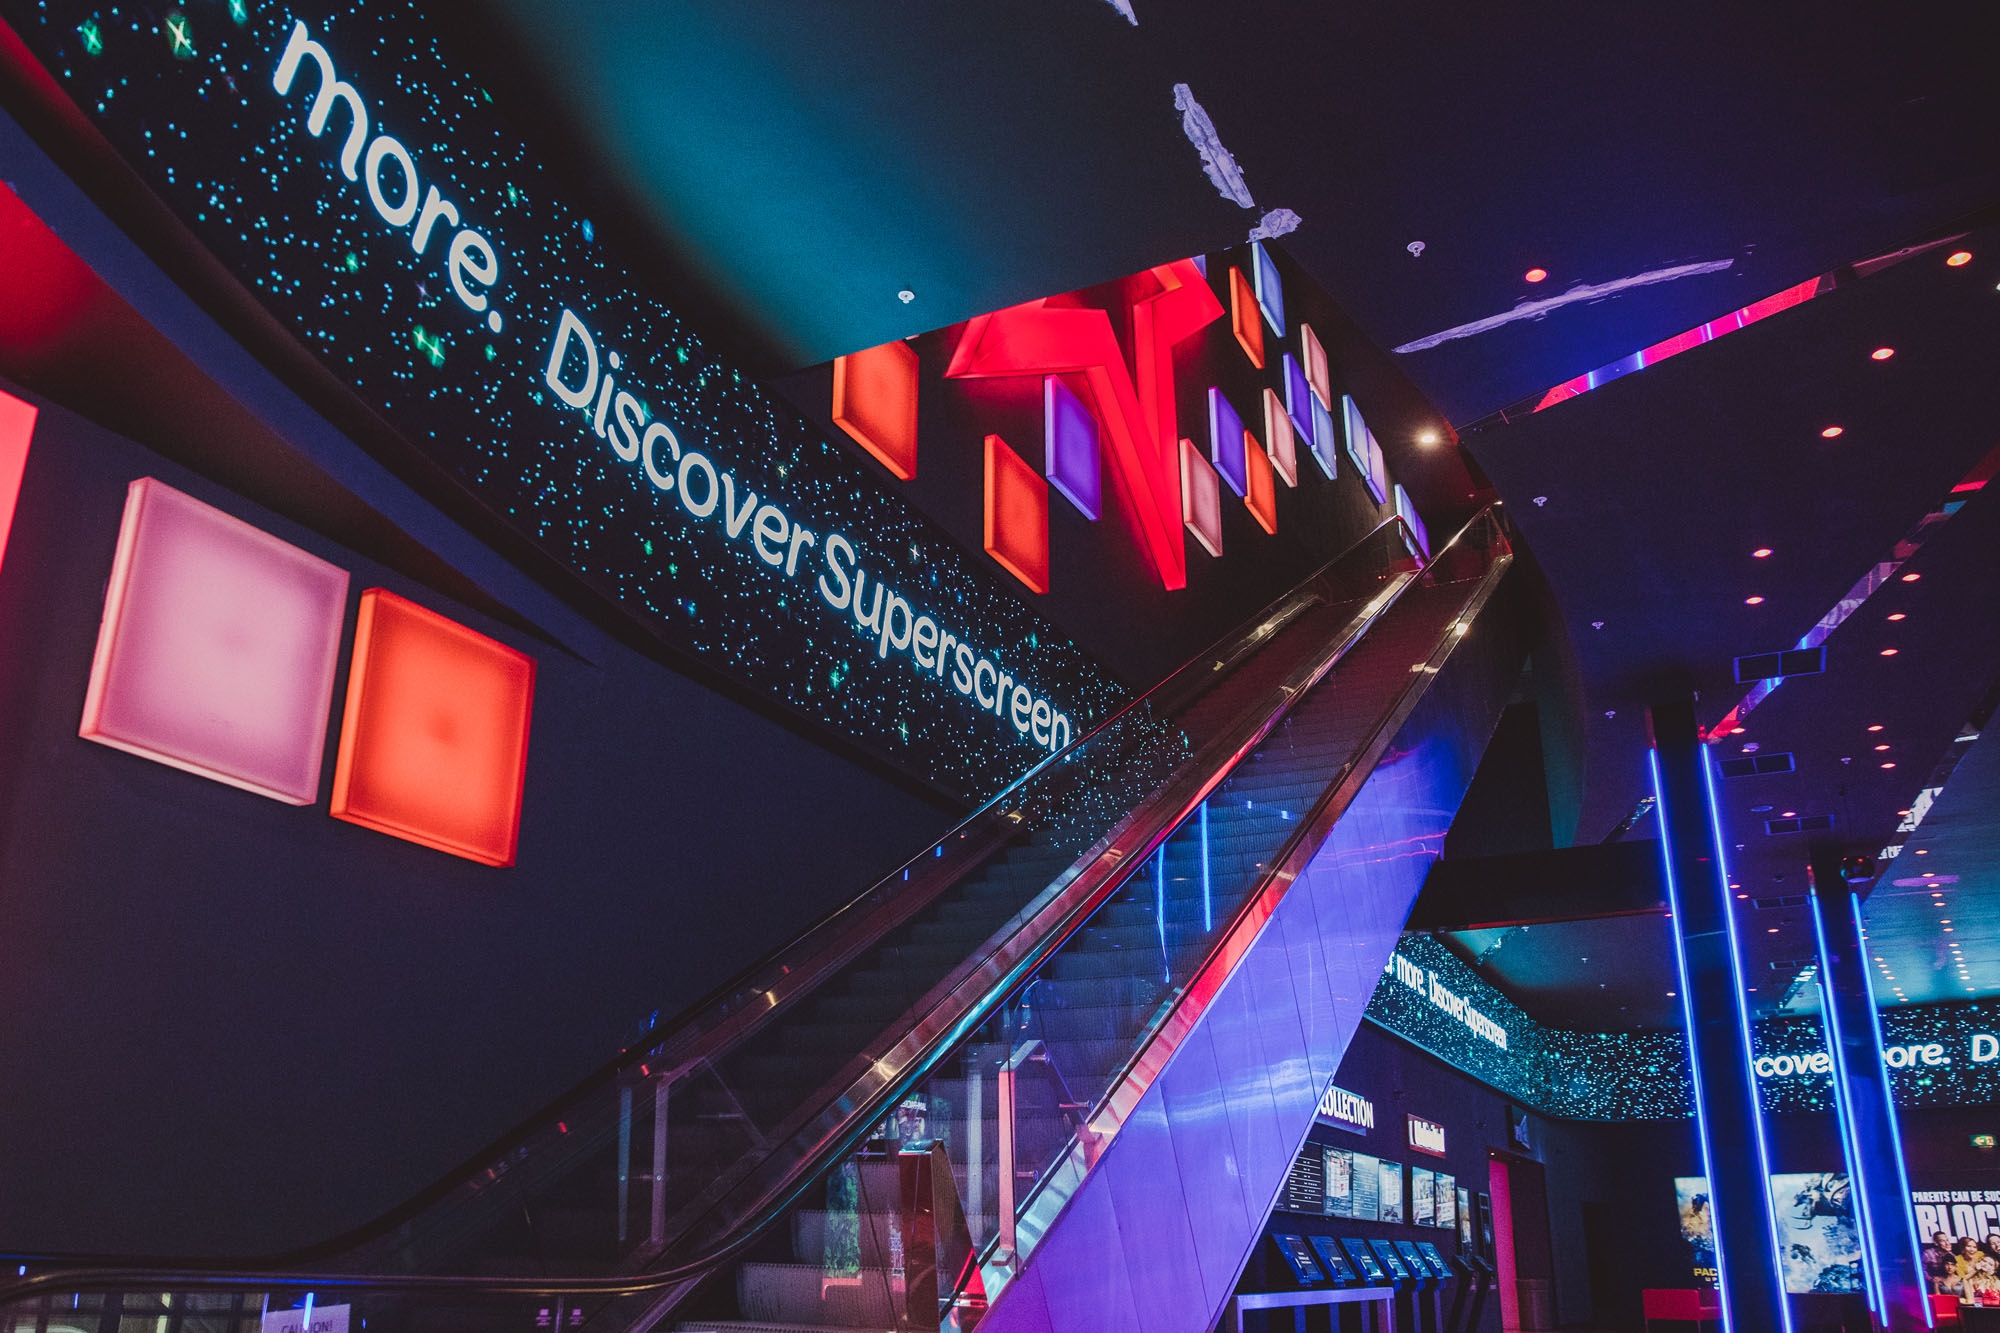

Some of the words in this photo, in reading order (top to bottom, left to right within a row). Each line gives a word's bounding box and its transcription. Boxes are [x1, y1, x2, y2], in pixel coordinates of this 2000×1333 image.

[273, 19, 502, 333] more.
[545, 309, 815, 577] Discover
[818, 534, 1070, 752] Superscreen
[1397, 954, 1426, 997] more.
[1429, 971, 1463, 1022] Discover
[1880, 1042, 1951, 1068] ore.
[1912, 1191, 1950, 1203] PARENTS
[1951, 1191, 1970, 1203] CAN
[1970, 1191, 1984, 1203] BE
[1914, 1204, 2000, 1244] BLOC
